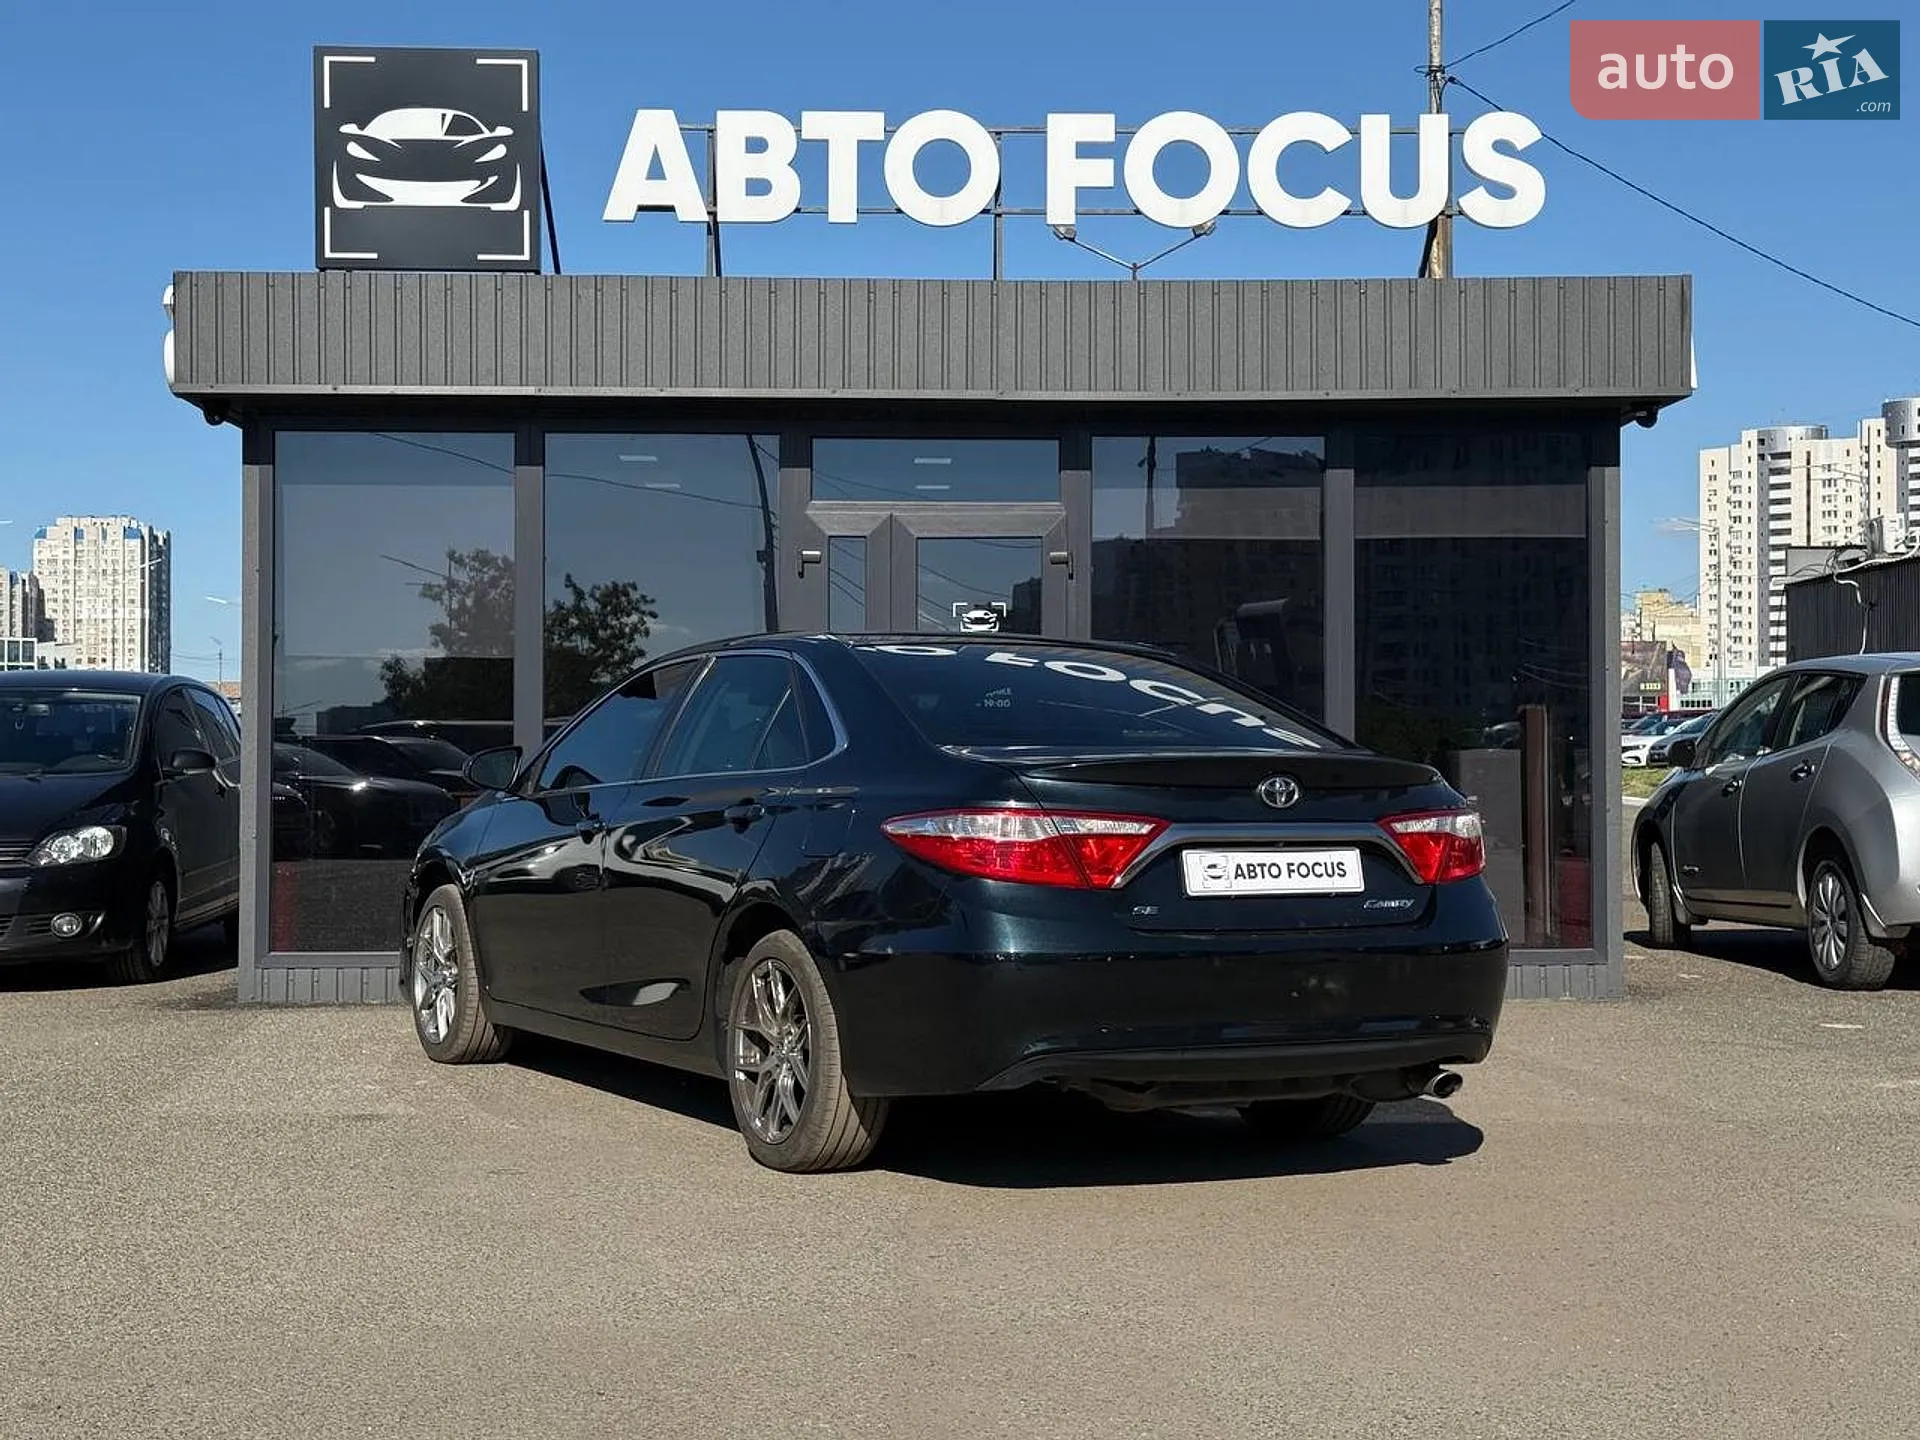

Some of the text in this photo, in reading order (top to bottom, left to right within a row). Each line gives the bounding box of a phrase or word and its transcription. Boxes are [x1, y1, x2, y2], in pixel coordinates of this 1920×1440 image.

[602, 109, 1547, 229] АВТО FOCUS
[1234, 861, 1347, 880] АВТО FOCUS
